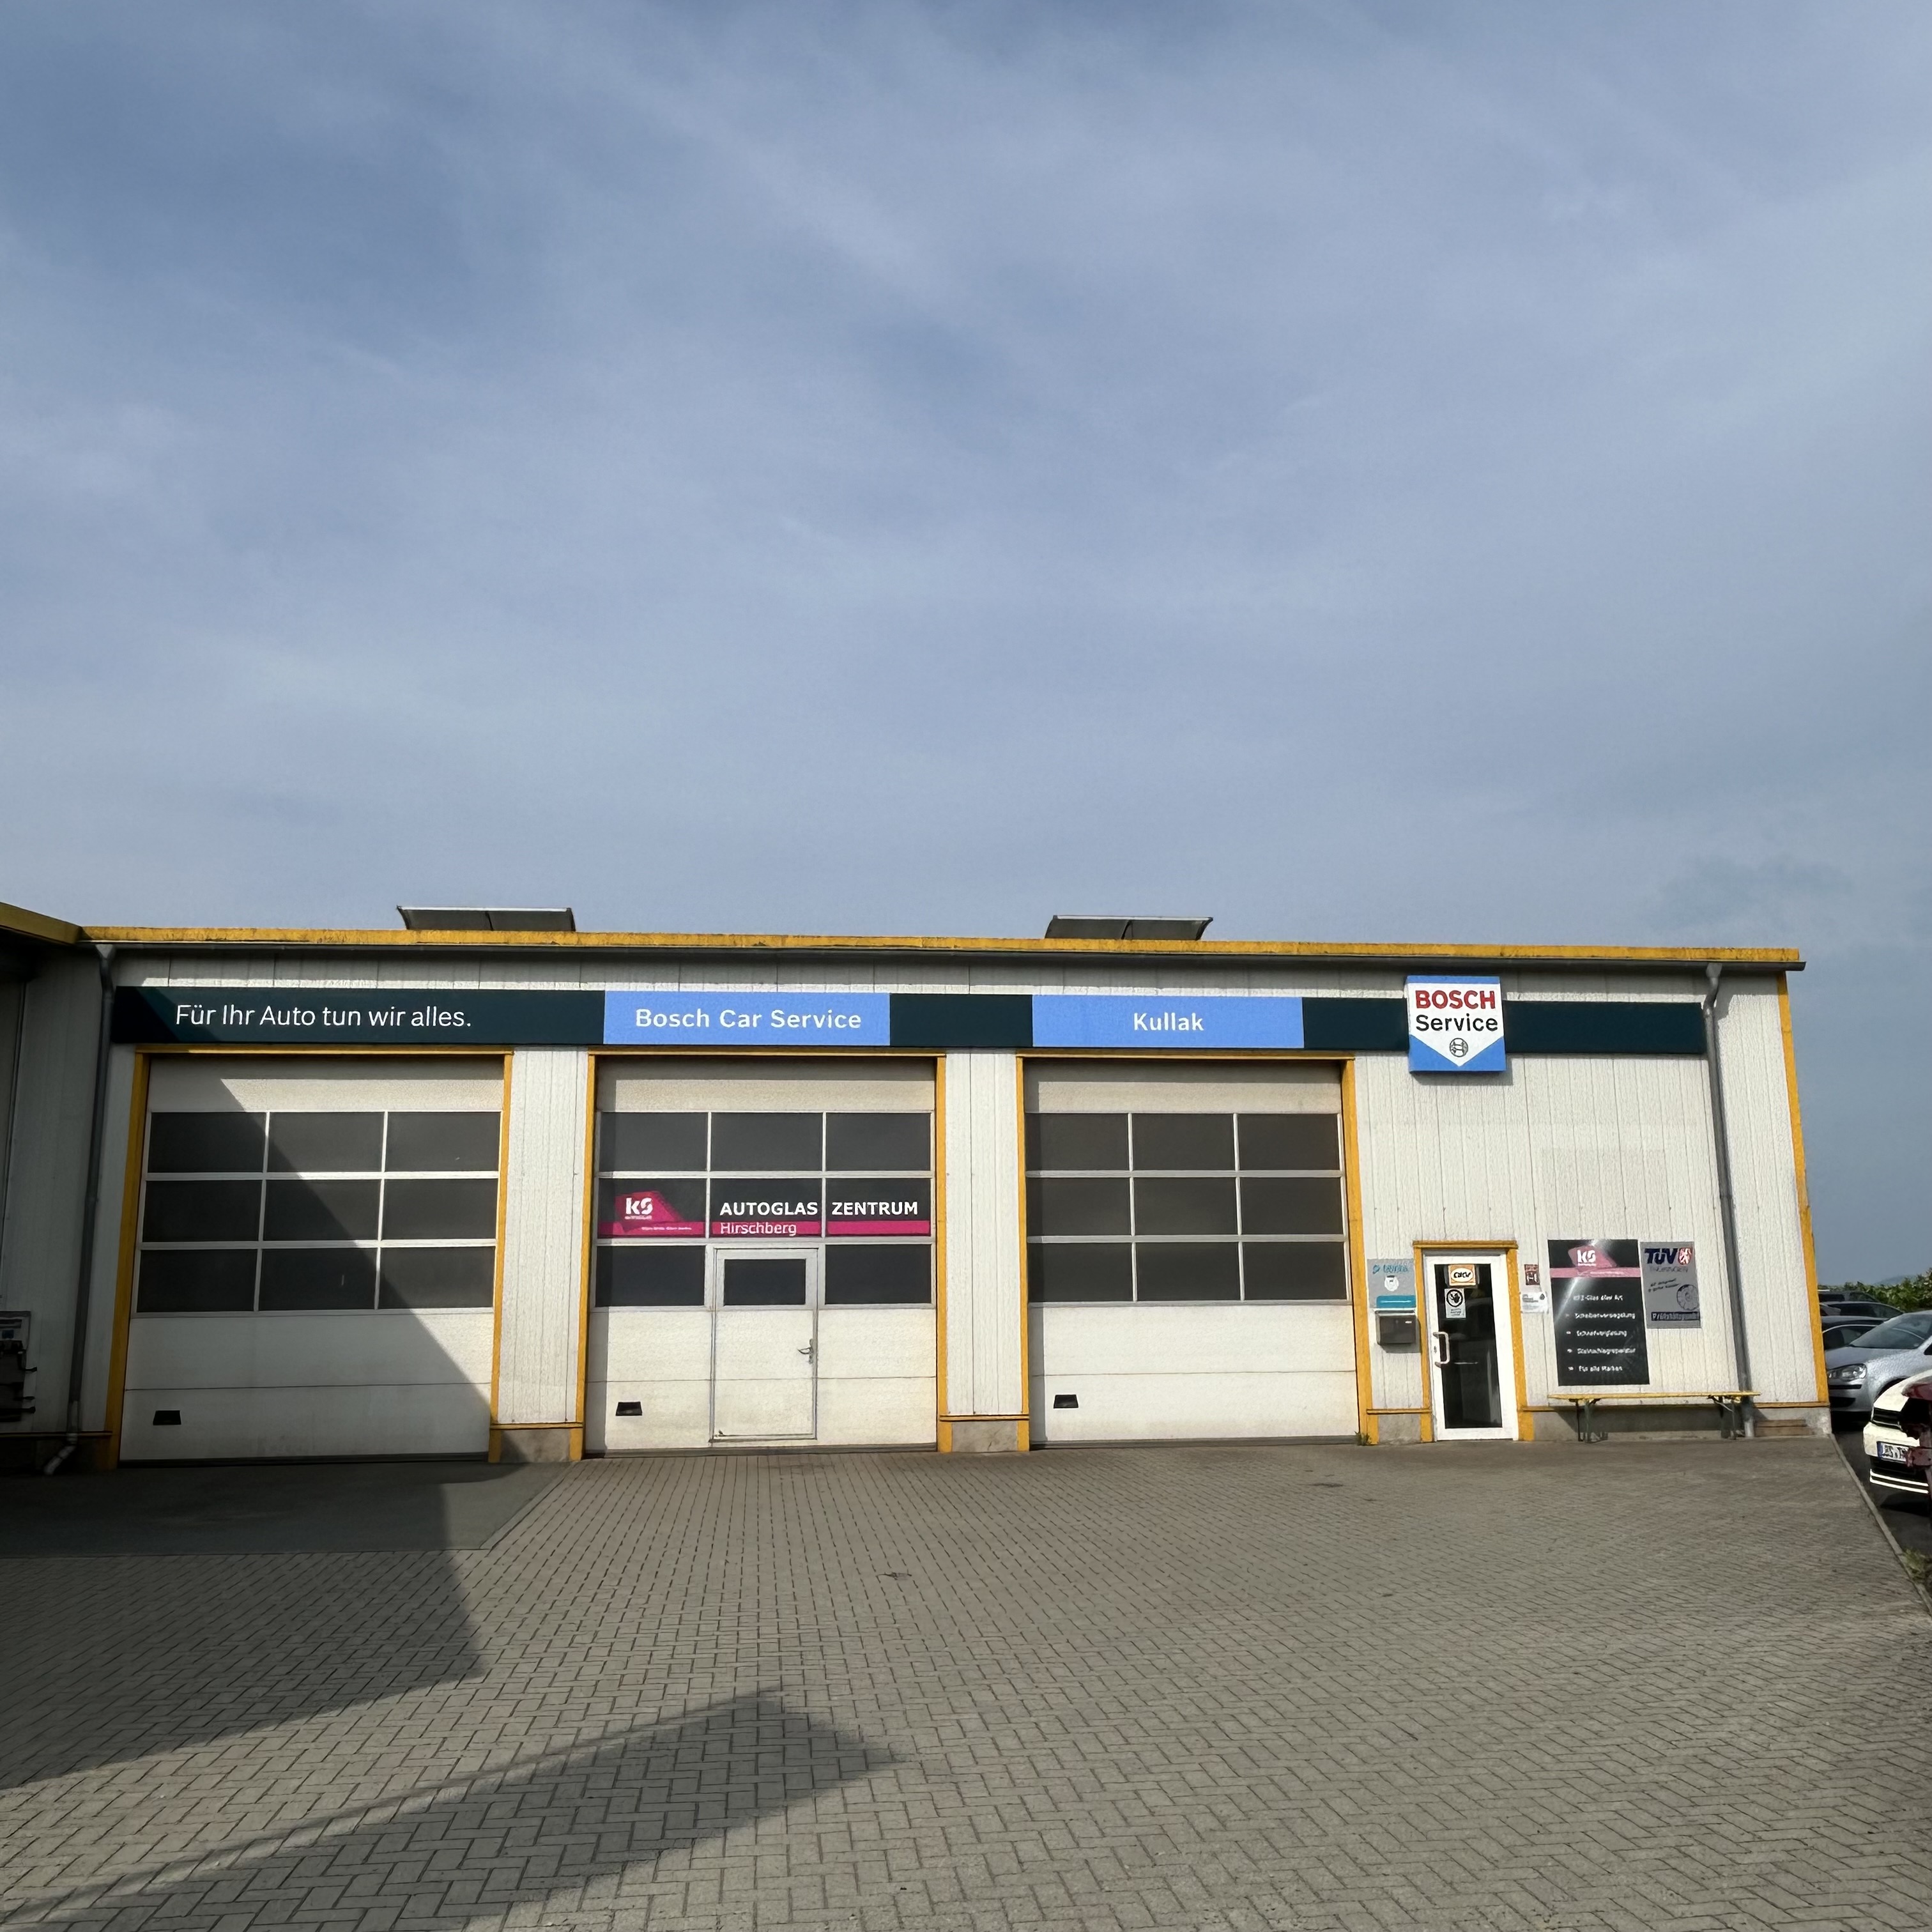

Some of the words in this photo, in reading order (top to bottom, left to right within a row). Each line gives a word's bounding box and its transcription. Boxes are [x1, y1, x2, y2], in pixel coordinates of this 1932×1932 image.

[1415, 990, 1496, 1009] BOSCH
[176, 1005, 216, 1024] Für
[223, 1004, 255, 1025] Ihr
[260, 1006, 315, 1025] Auto
[323, 1007, 360, 1025] tun
[369, 1006, 406, 1025] wir
[411, 1006, 470, 1026] alles.
[636, 1009, 709, 1027] Bosch
[720, 1010, 762, 1027] Car
[771, 1010, 861, 1028] Service
[1135, 1013, 1203, 1030] Kullak
[1416, 1013, 1498, 1032] Service
[720, 1202, 817, 1215] AUTOGLAS
[832, 1202, 917, 1215] ZENTRUM
[720, 1222, 797, 1236] Hirschberg
[1644, 1248, 1678, 1264] TÜV
